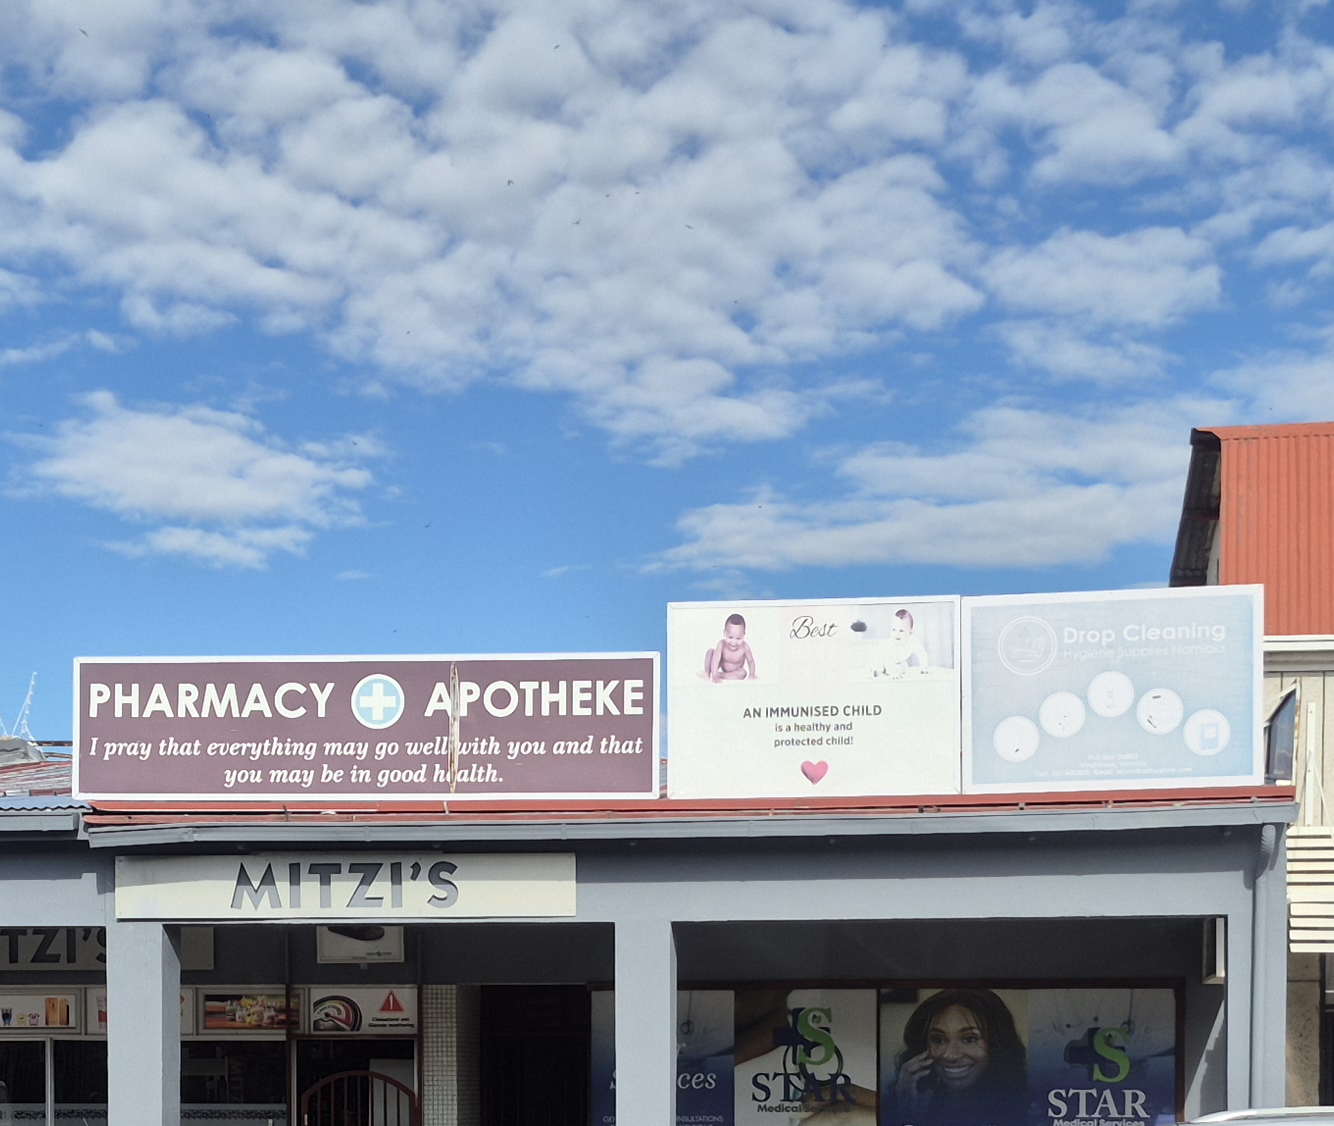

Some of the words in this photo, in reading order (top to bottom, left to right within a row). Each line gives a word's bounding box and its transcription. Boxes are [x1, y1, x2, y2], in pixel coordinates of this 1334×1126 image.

[790, 616, 839, 640] Best
[1064, 627, 1115, 646] Drop
[1122, 622, 1226, 642] Cleaning
[1064, 648, 1115, 661] Hygiene
[1118, 646, 1167, 659] Supplies
[1170, 643, 1225, 656] Namibia
[89, 682, 335, 718] PHARMACY
[424, 680, 644, 717] APOTHEKE
[743, 708, 762, 718] AN
[766, 706, 839, 717] IMMUNISED
[843, 705, 882, 716] CHILD
[775, 723, 783, 732] is
[794, 723, 831, 733] healthy
[834, 722, 853, 731] and
[89, 738, 99, 756] I
[103, 741, 152, 760] pray
[158, 737, 201, 756] that
[207, 737, 317, 760] everything
[323, 741, 368, 760] may
[375, 742, 399, 760] go
[406, 737, 448, 755] well
[458, 737, 501, 755] with
[507, 741, 546, 759] you
[553, 736, 594, 755] and
[600, 735, 643, 754] that
[774, 736, 823, 748] protected
[826, 736, 854, 745] child!
[224, 769, 262, 787] you
[269, 769, 314, 787] may
[320, 765, 344, 783] be
[350, 766, 372, 783] in
[377, 764, 426, 787] good
[230, 861, 459, 911] MITZI'S
[752, 1072, 854, 1103] STAR
[757, 1104, 802, 1113] Medical
[1048, 1088, 1151, 1119] STAR
